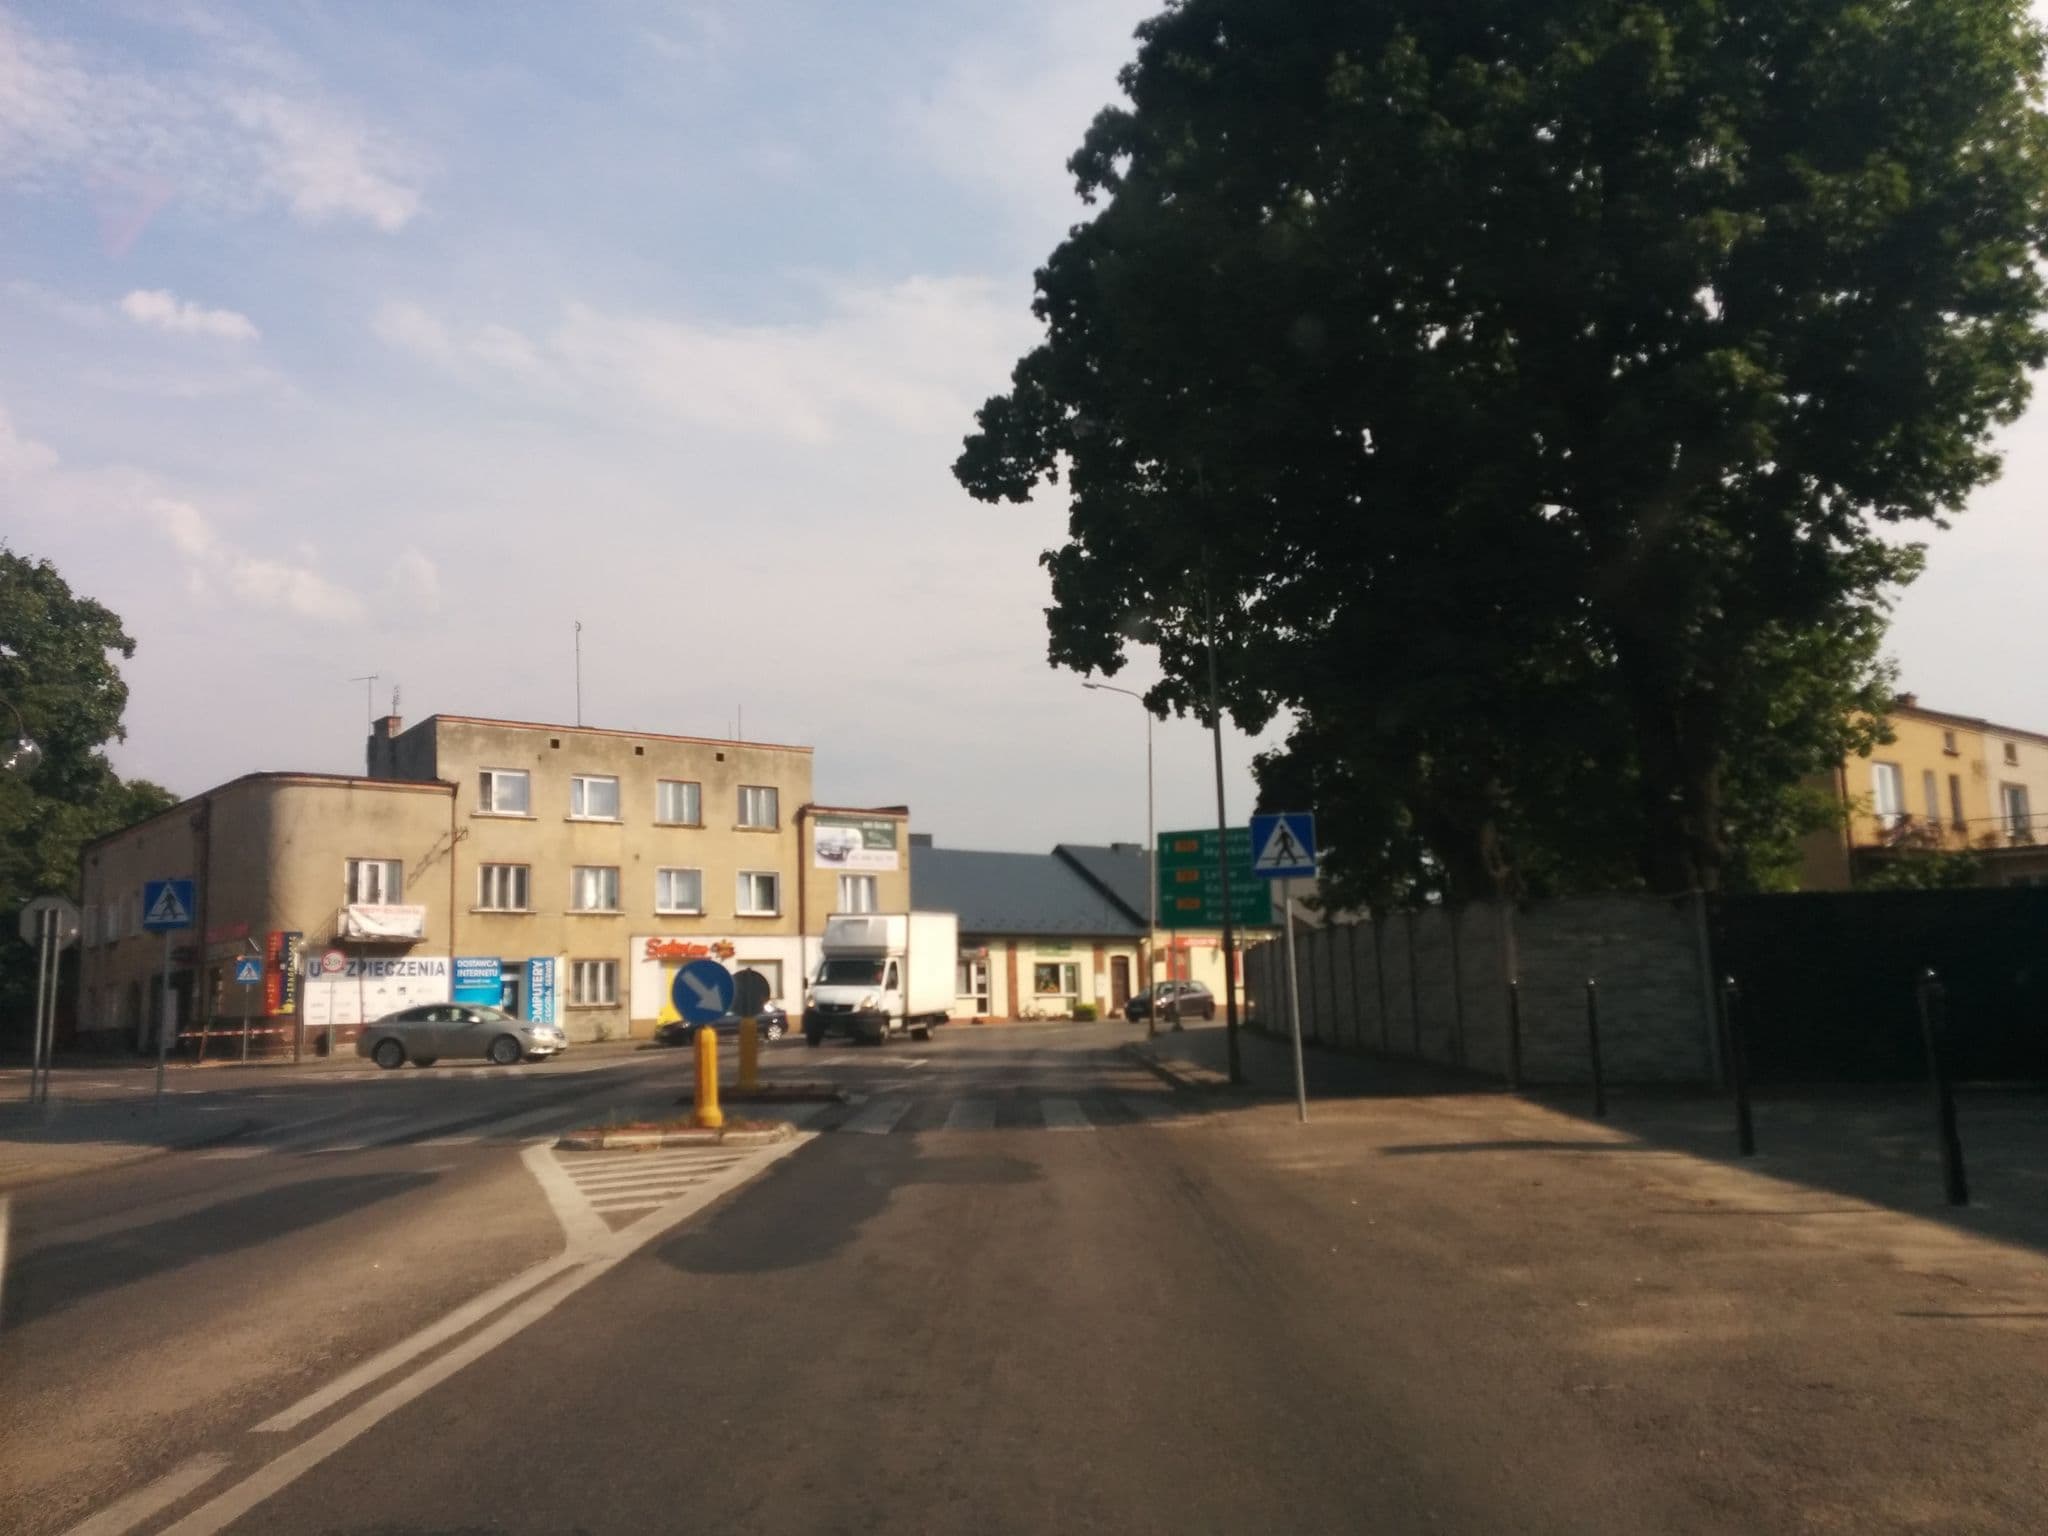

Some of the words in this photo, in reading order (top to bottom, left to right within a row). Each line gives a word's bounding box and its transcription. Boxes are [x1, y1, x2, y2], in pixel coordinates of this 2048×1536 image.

[310, 960, 446, 977] UZPIECZENIA
[457, 959, 498, 967] DOSTAWCA
[457, 968, 498, 977] INTERNETU
[532, 960, 543, 1024] OMPUTERY
